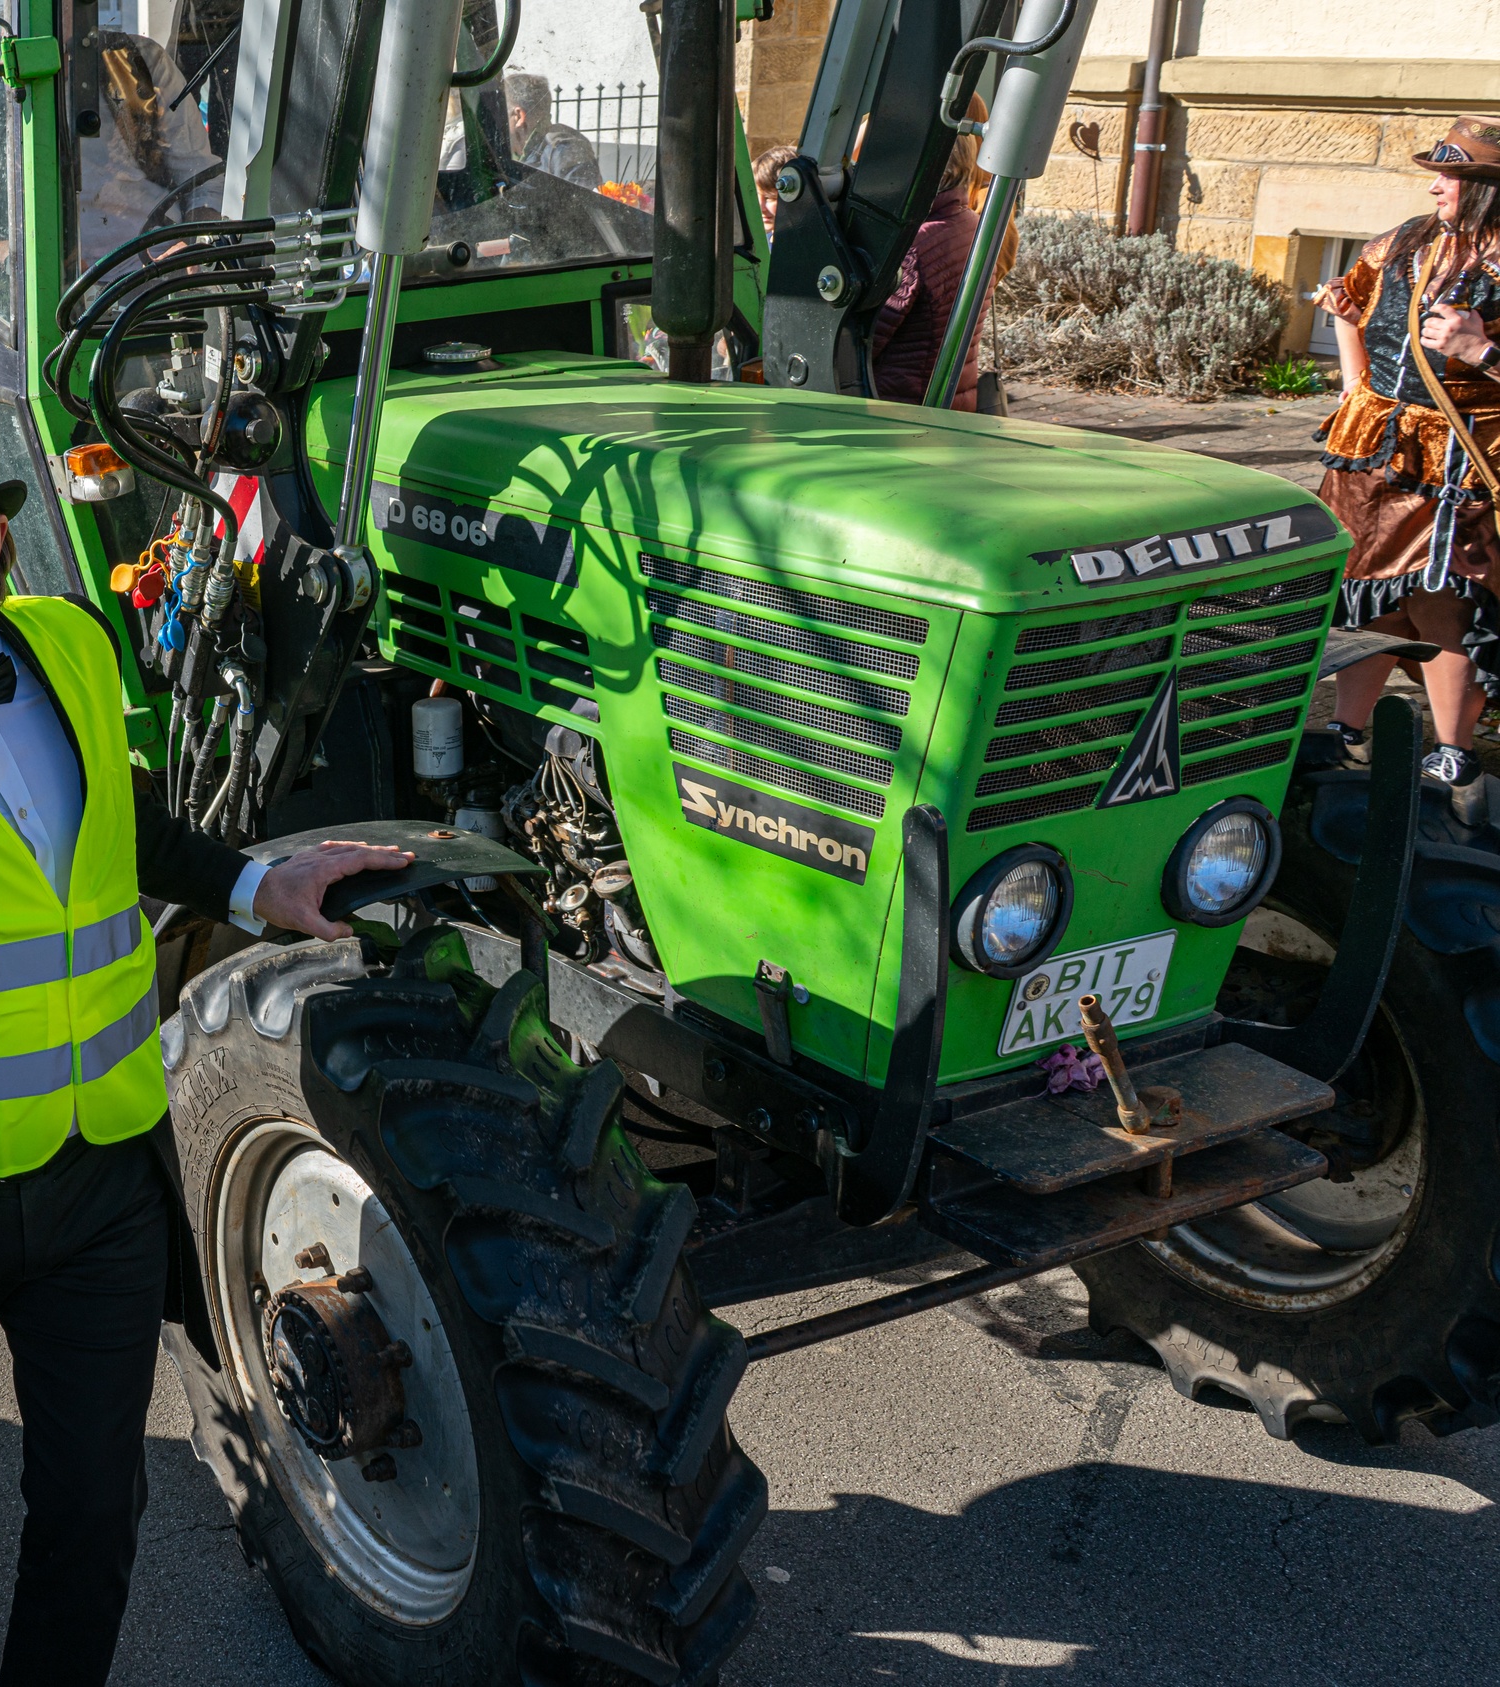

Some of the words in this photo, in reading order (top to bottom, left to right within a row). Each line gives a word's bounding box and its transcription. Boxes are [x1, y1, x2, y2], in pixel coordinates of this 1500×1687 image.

[389, 497, 406, 524] D
[1070, 515, 1301, 583] DEUTZ
[681, 778, 866, 872] Synchron
[1054, 947, 1136, 995] BIT
[1008, 998, 1071, 1049] AK
